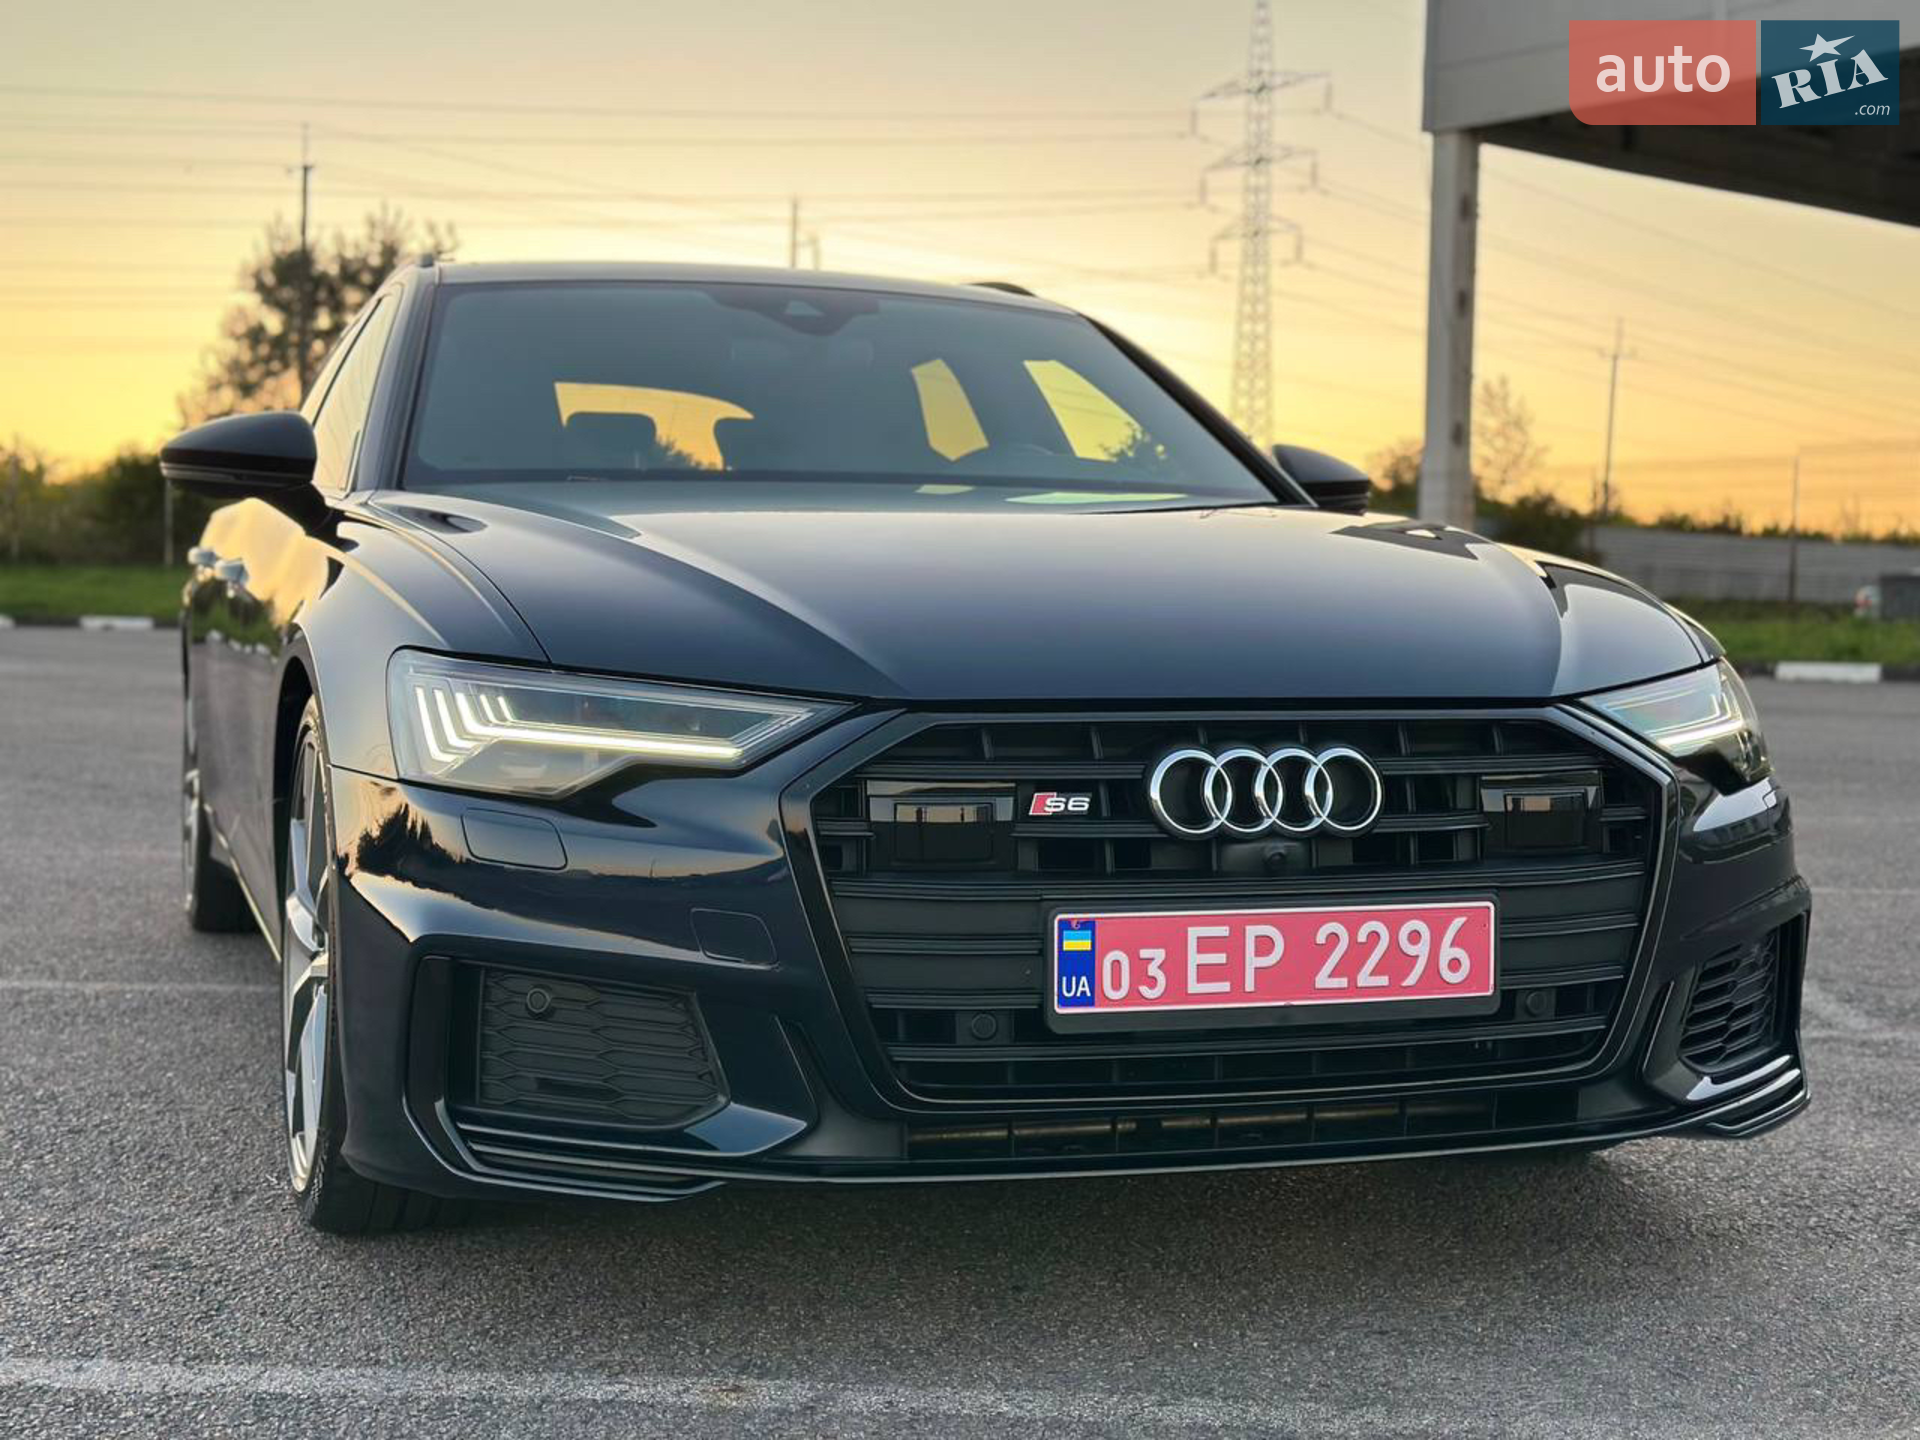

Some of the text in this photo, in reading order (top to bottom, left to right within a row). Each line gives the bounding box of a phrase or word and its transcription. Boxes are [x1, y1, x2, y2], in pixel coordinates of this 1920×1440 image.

[1043, 797, 1091, 812] S6
[1102, 916, 1471, 1000] 03 EP 2296
[1062, 975, 1091, 997] UA
